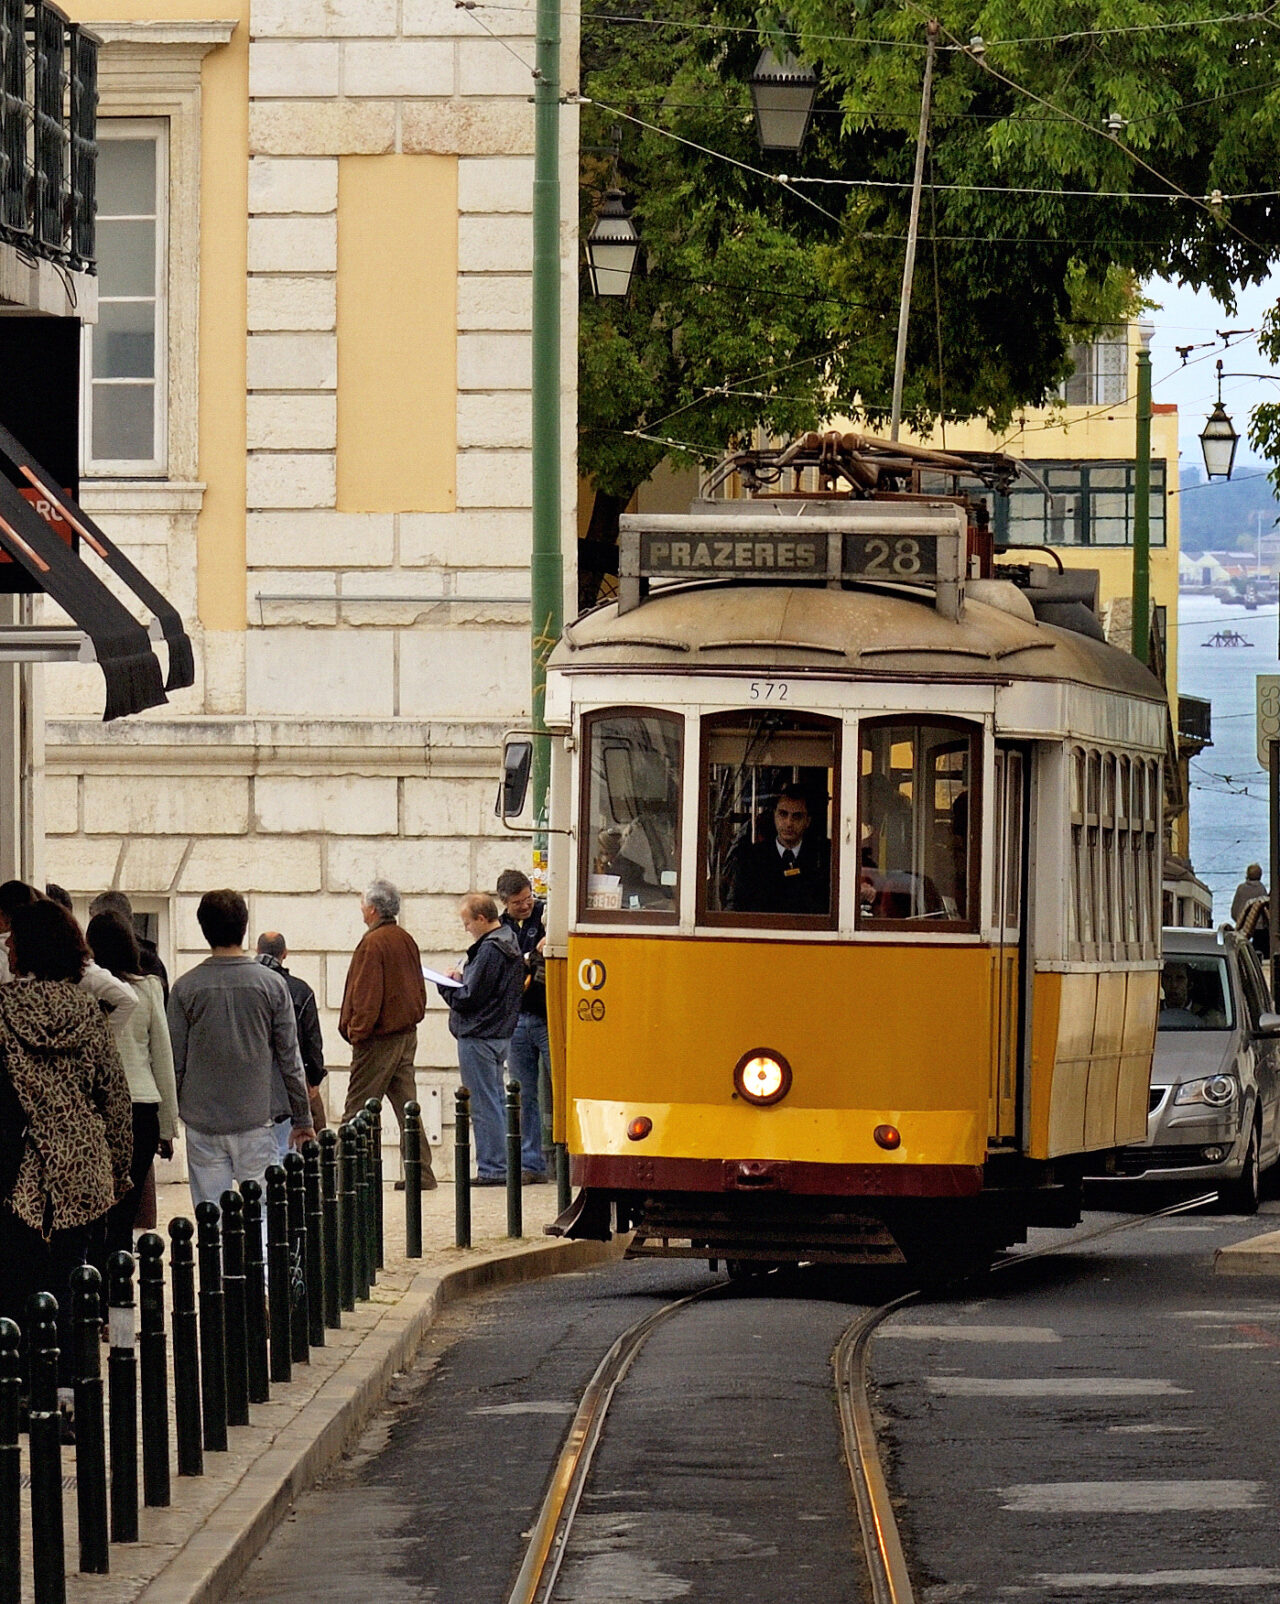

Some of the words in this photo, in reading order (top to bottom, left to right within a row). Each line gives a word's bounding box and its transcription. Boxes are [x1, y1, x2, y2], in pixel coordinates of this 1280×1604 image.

[651, 541, 816, 568] PRAZERES
[863, 538, 921, 576] 28
[750, 682, 788, 700] 572
[1260, 685, 1280, 765] oces
